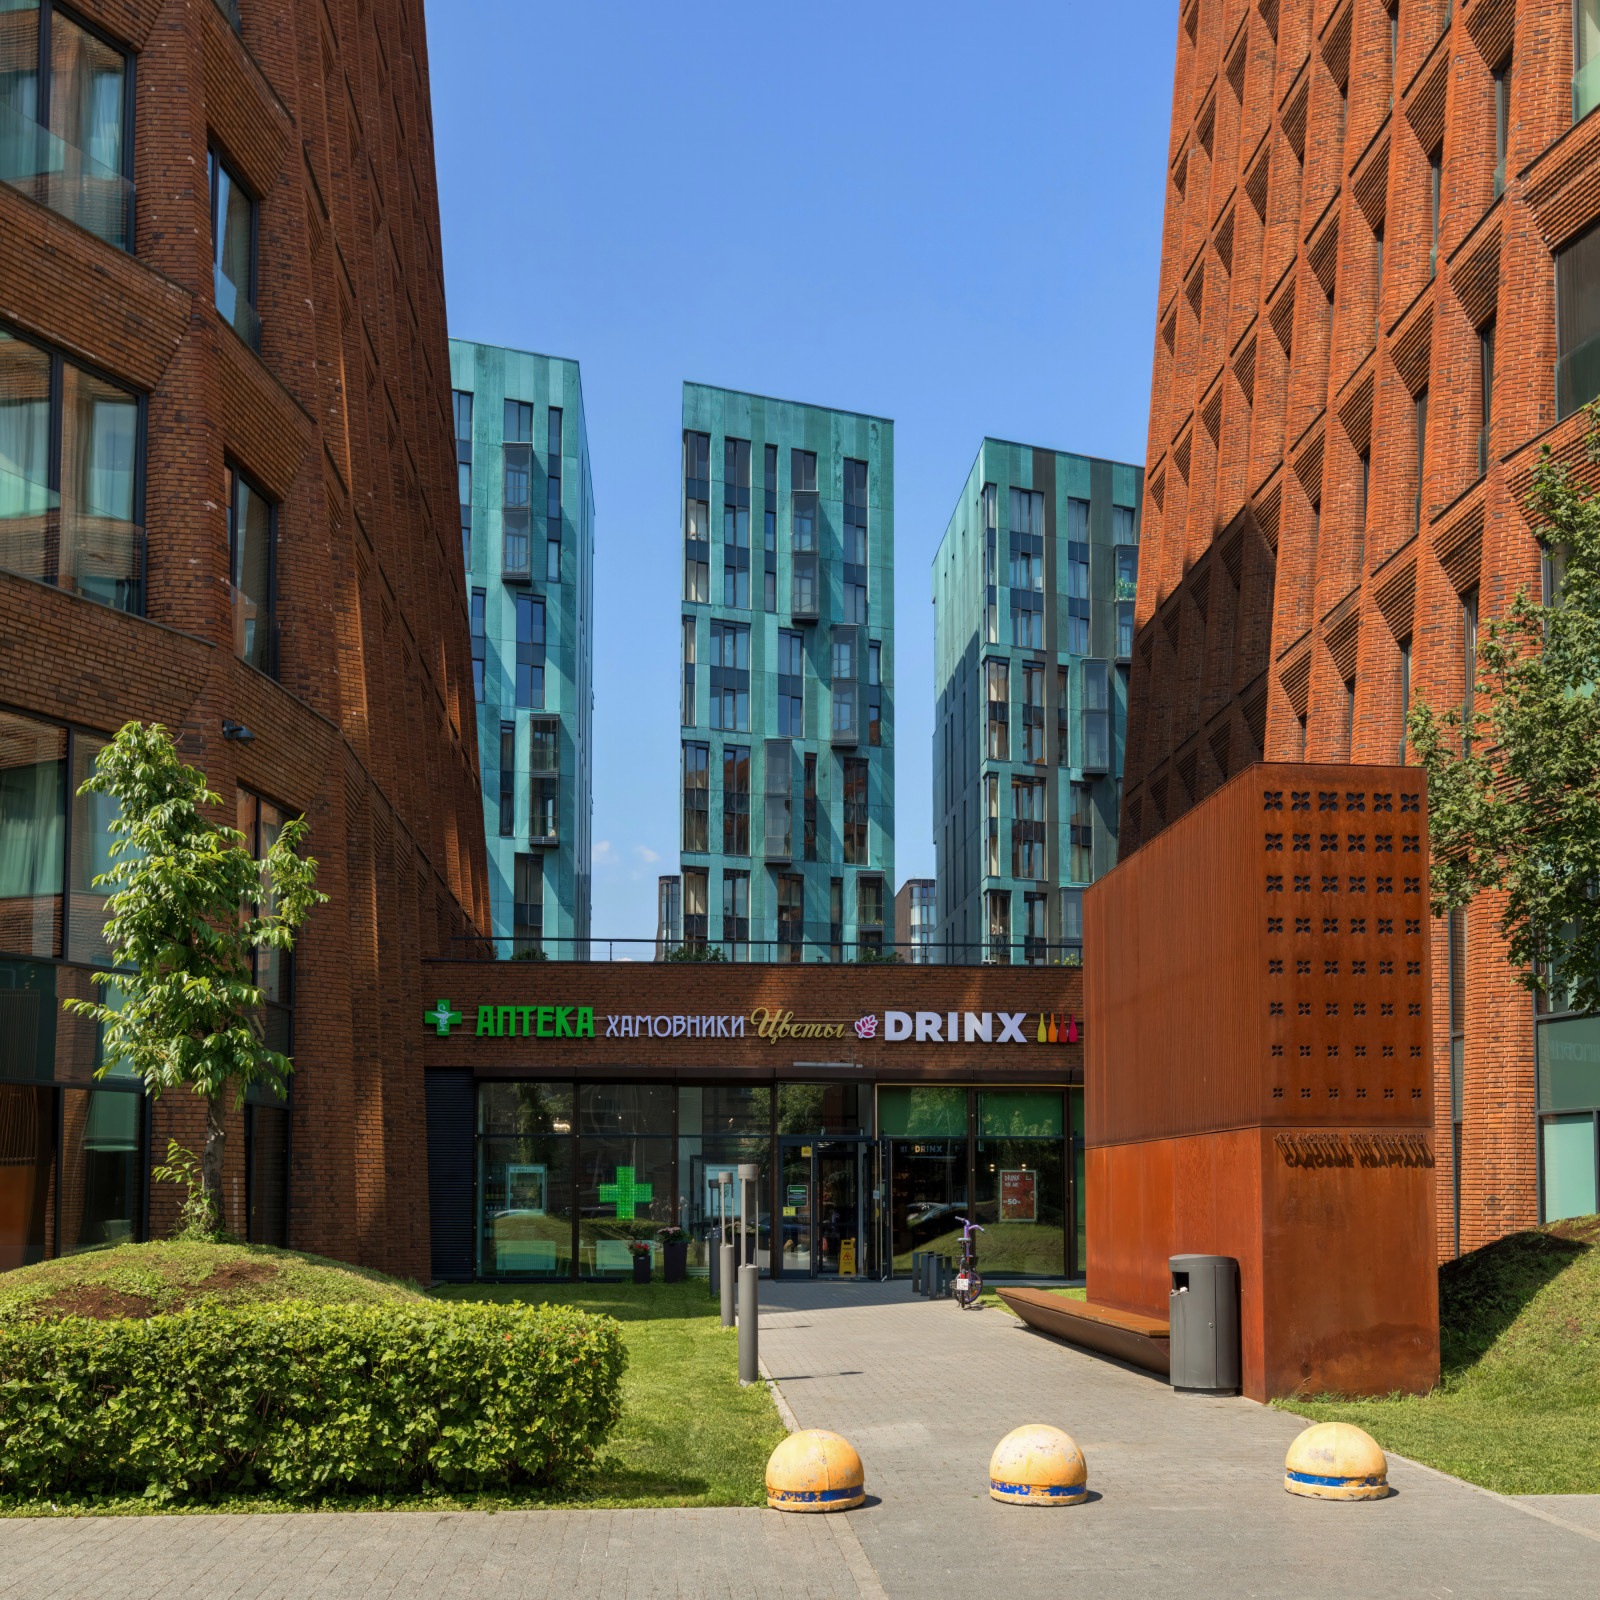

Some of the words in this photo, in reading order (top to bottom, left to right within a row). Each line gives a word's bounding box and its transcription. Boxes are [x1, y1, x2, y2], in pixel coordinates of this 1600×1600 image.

[475, 1005, 595, 1037] АПТЕКА
[605, 1015, 744, 1038] ХАМОВНИКИ
[750, 1007, 846, 1045] Цветы
[884, 1010, 1028, 1043] DRINX
[914, 1145, 943, 1153] DRINX
